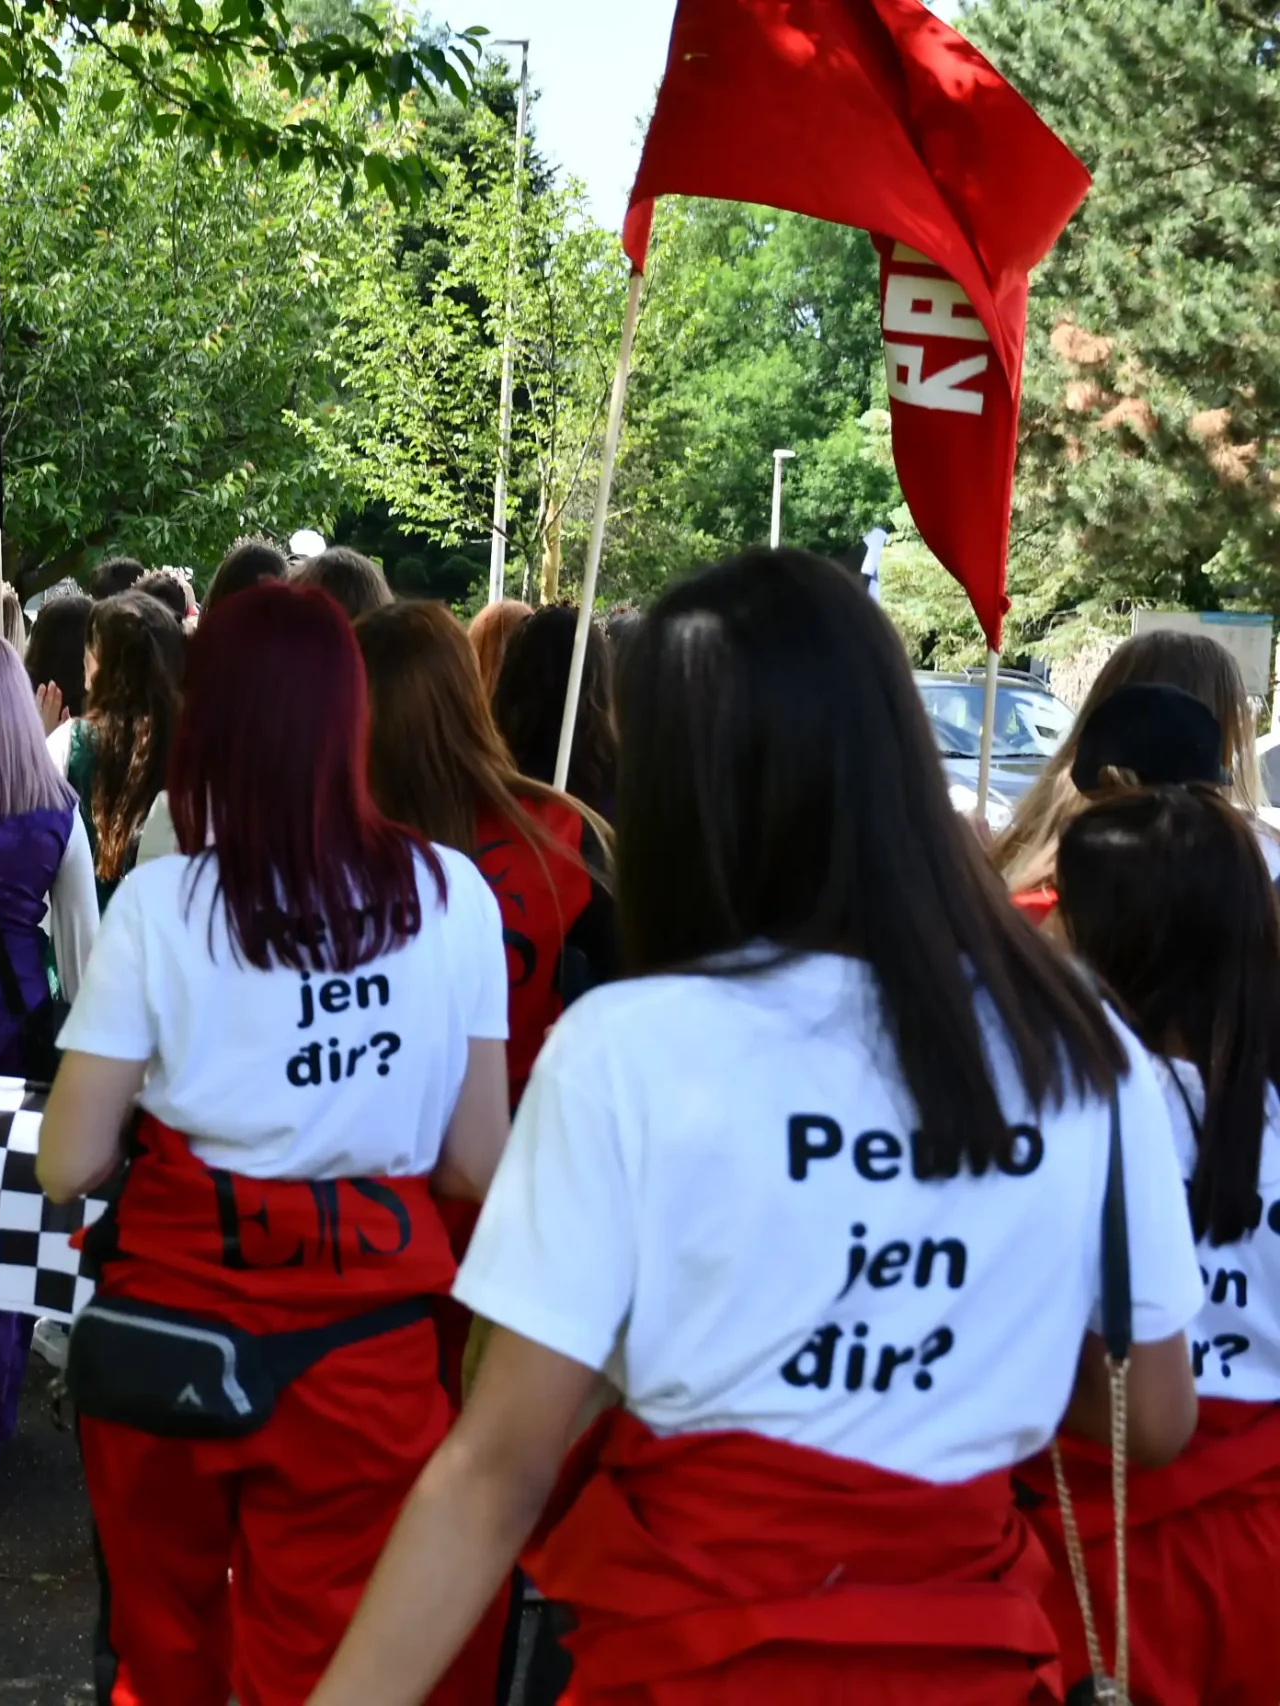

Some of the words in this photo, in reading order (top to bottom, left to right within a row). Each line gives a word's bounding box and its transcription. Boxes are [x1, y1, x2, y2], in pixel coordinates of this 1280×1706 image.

[883, 241, 988, 416] RA
[297, 971, 389, 1029] jen
[286, 1031, 402, 1087] đir?
[787, 1113, 1044, 1183] Peo
[836, 1221, 967, 1303] jen
[779, 1322, 954, 1392] đir?
